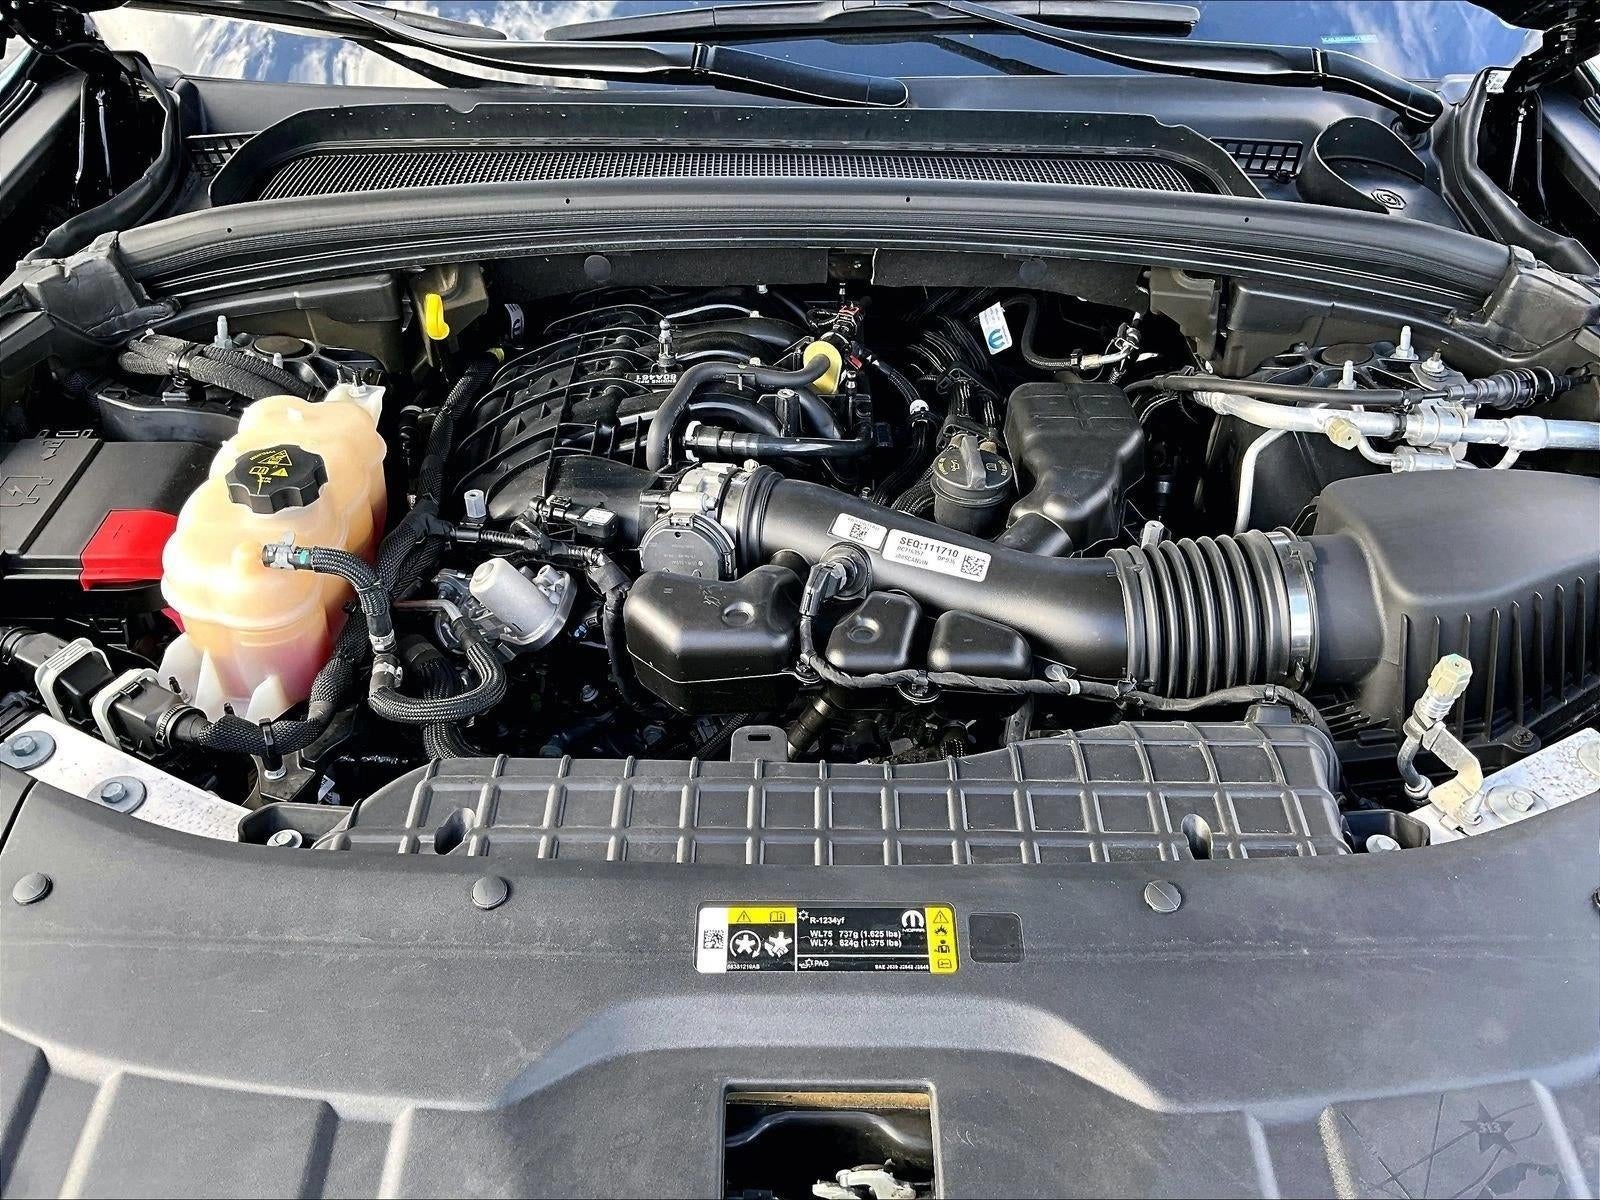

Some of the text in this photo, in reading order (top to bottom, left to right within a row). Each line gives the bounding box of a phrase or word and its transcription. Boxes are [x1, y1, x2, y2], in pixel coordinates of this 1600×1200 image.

[899, 536, 959, 558] SEQ:111710
[809, 916, 845, 926] R-1234yf
[810, 929, 902, 939] WL75 737g (1.625 lbs)
[810, 939, 833, 947] WL74
[861, 938, 885, 948] (1.375
[886, 938, 902, 947] lbs)
